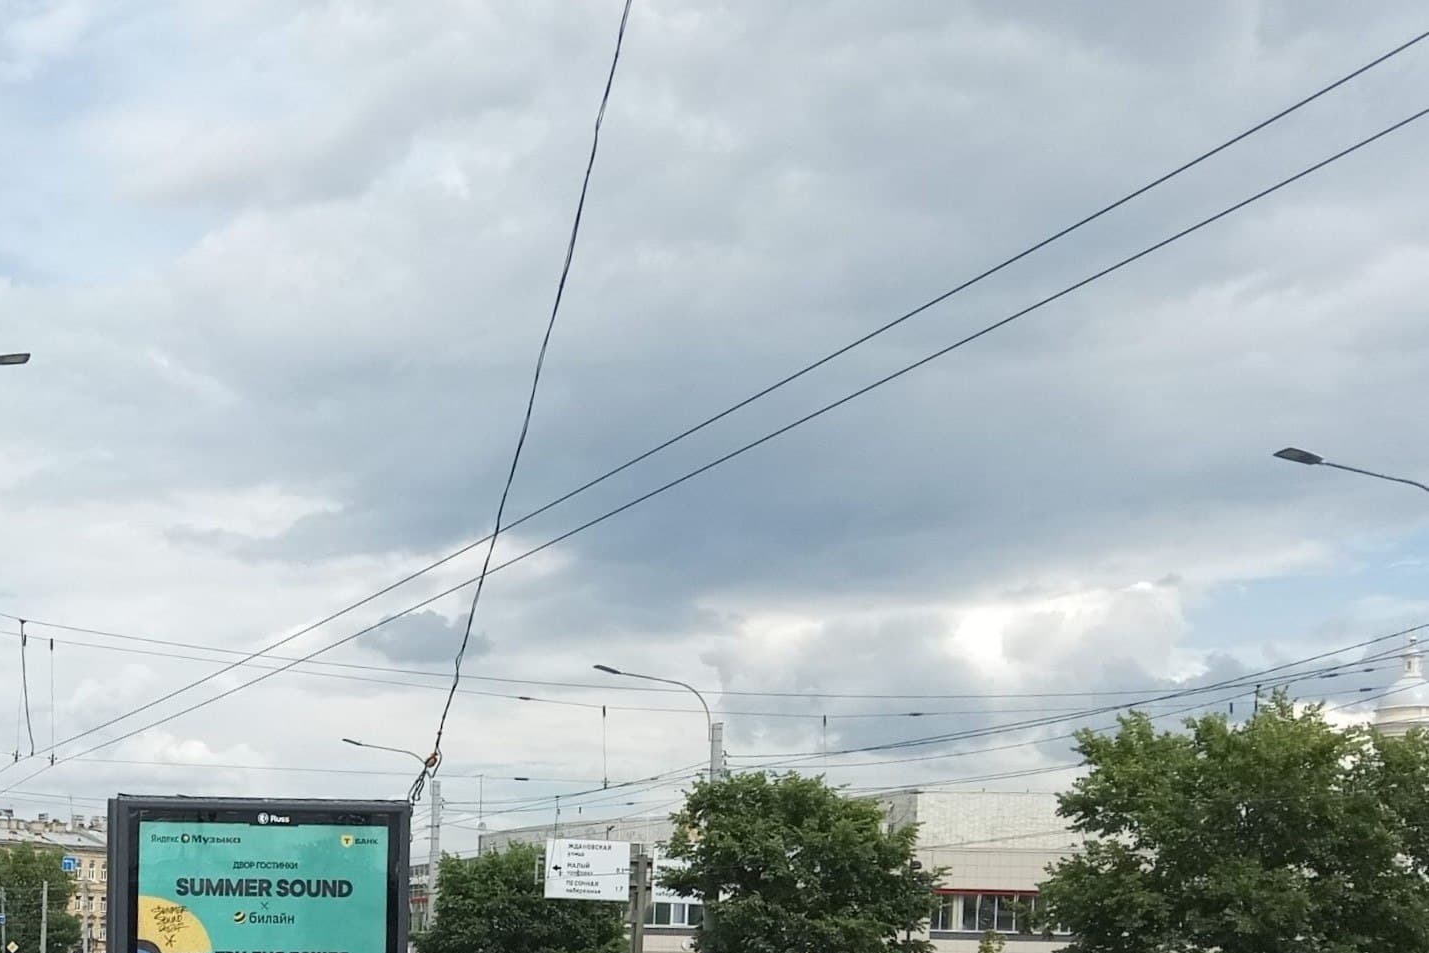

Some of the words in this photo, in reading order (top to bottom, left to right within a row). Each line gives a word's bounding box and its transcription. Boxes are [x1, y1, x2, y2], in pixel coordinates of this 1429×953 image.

[192, 834, 241, 845] Музыка
[233, 861, 255, 870] ДВОР
[256, 861, 298, 870] ГОСТИНКИ
[176, 878, 272, 897] SUMMER
[276, 879, 353, 898] SOUND
[249, 912, 295, 925] билайн
